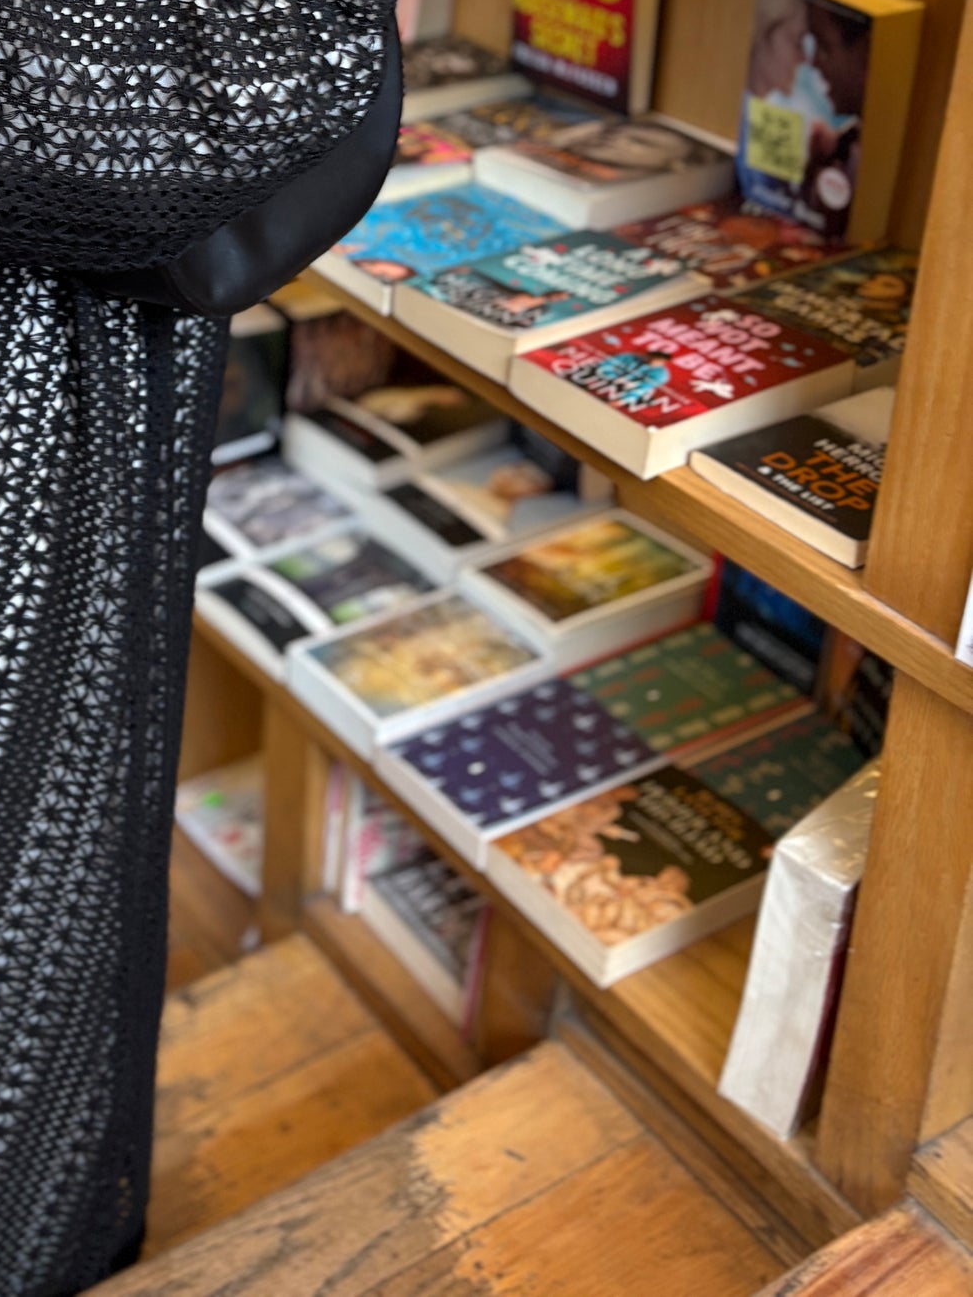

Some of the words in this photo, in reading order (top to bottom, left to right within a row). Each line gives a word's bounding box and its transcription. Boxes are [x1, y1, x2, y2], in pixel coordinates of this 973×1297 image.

[645, 317, 766, 374] MEANT
[694, 317, 771, 353] NOT
[732, 313, 782, 339] SO
[632, 330, 680, 353] TO
[672, 352, 724, 381] BE
[551, 358, 651, 414] QUINN
[805, 450, 879, 497] THE
[813, 438, 882, 483] HERRO
[846, 443, 885, 470] MIC
[760, 451, 871, 511] DROP
